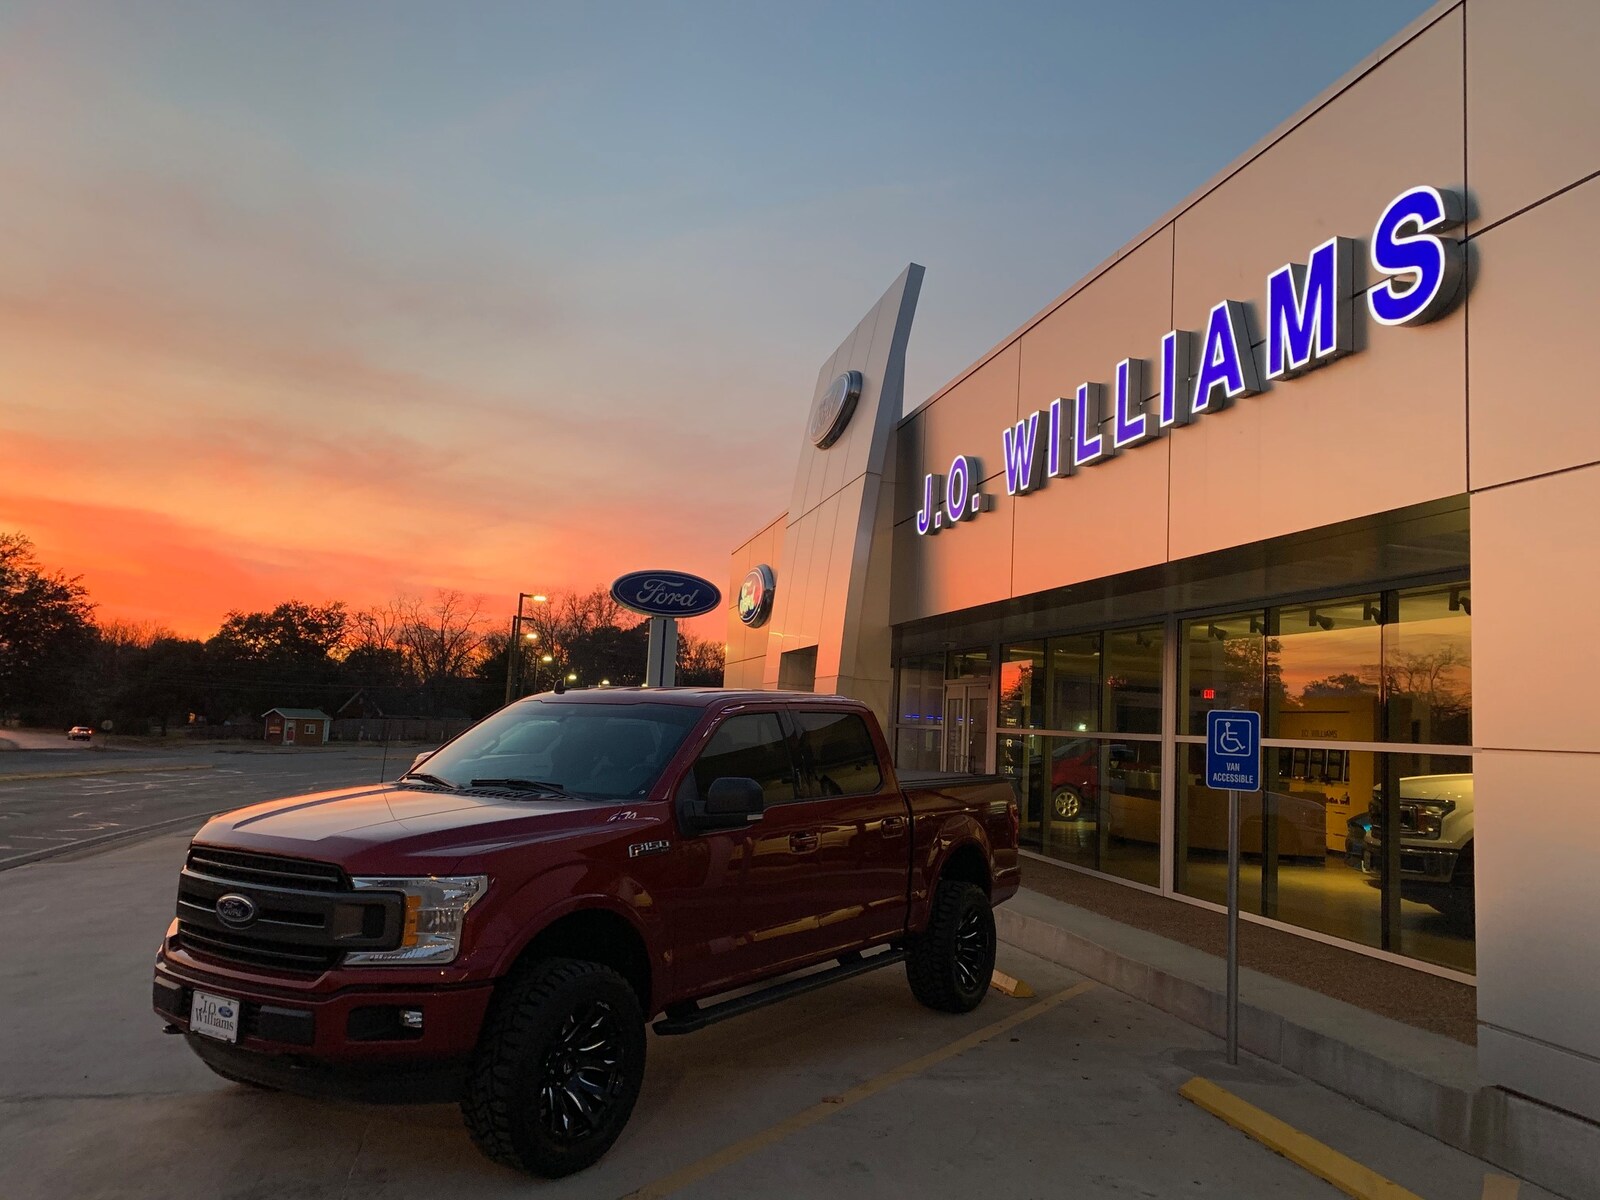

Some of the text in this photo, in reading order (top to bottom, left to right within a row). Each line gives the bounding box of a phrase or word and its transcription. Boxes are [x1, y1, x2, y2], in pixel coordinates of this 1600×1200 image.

[917, 184, 1452, 535] J.O. WILLIAMS
[636, 579, 699, 607] Ford
[1212, 772, 1254, 784] ACCESSIBLE
[1226, 762, 1240, 772] VAN
[195, 1007, 234, 1031] Williams
